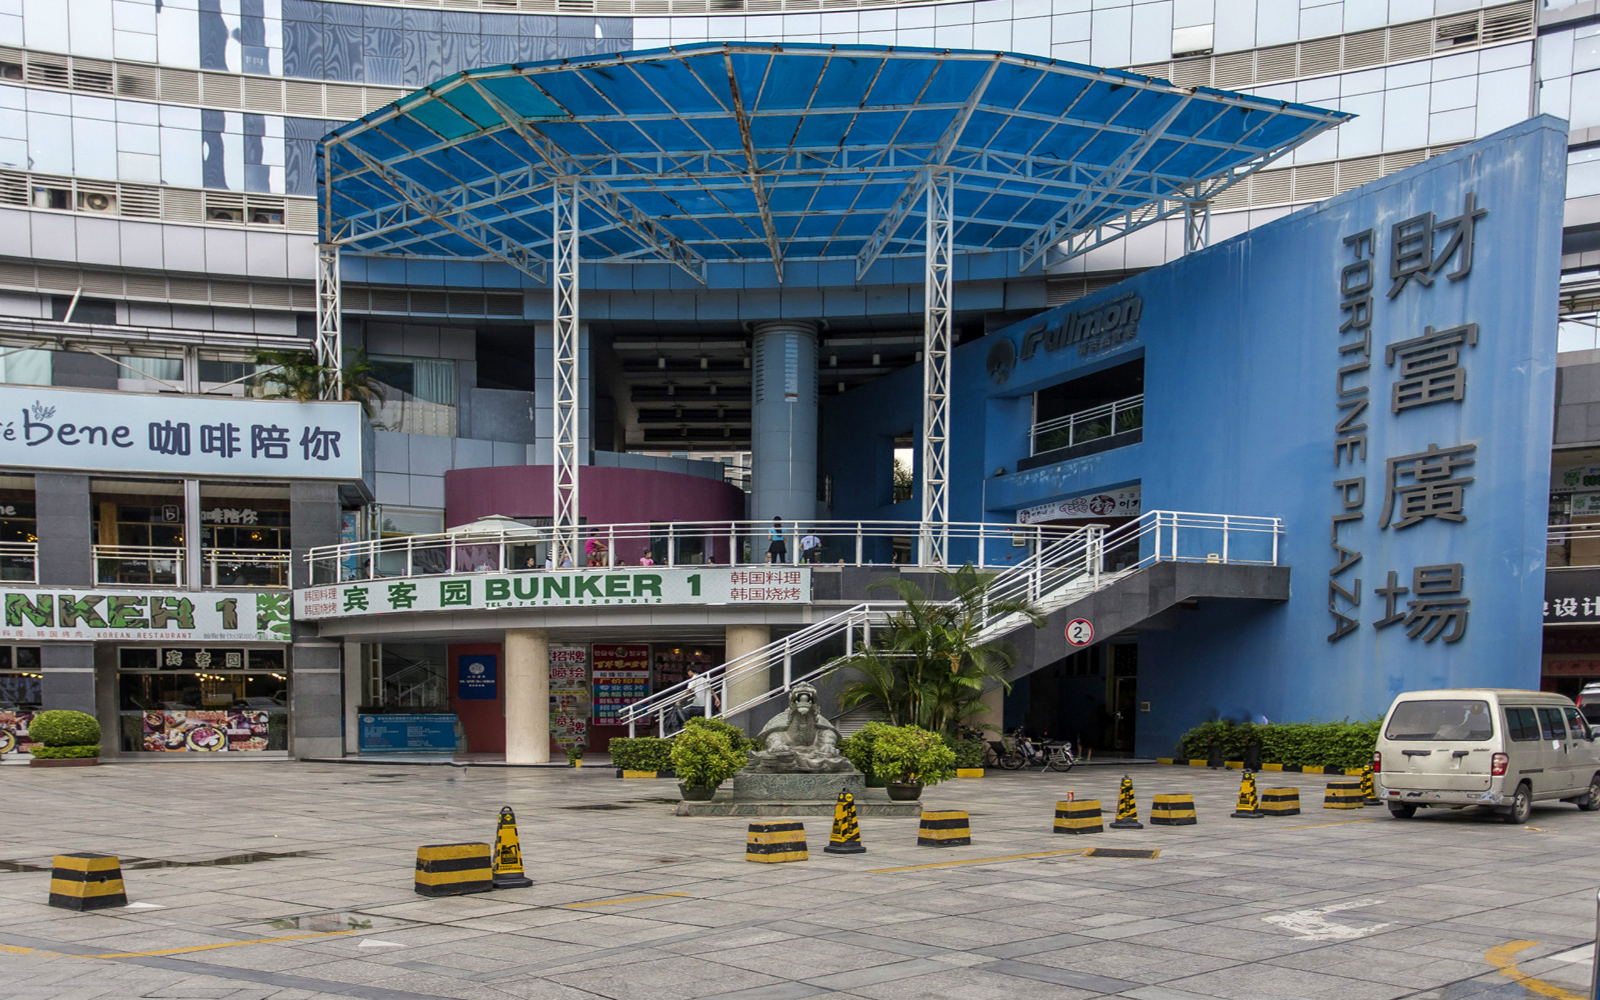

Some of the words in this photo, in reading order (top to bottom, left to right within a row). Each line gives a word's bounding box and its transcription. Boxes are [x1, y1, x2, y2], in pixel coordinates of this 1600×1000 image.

[1019, 297, 1143, 360] Fullmon
[1334, 227, 1375, 464] FORTUNE
[0, 421, 16, 441] é
[22, 408, 134, 448] bene
[1372, 192, 1488, 643] 財富廣場
[149, 420, 341, 461] 咖啡陪你
[730, 571, 800, 585] 韩国料理
[1327, 476, 1364, 643] PLAZA
[304, 588, 337, 602] 韩国料理
[343, 579, 472, 612] 宾客园
[485, 574, 662, 601] BUNKER
[687, 574, 701, 597] 1
[730, 587, 800, 601] 韩国烧烤
[5, 593, 196, 629] NKER
[216, 598, 238, 630] 1
[304, 602, 337, 616] 韩国烧烤
